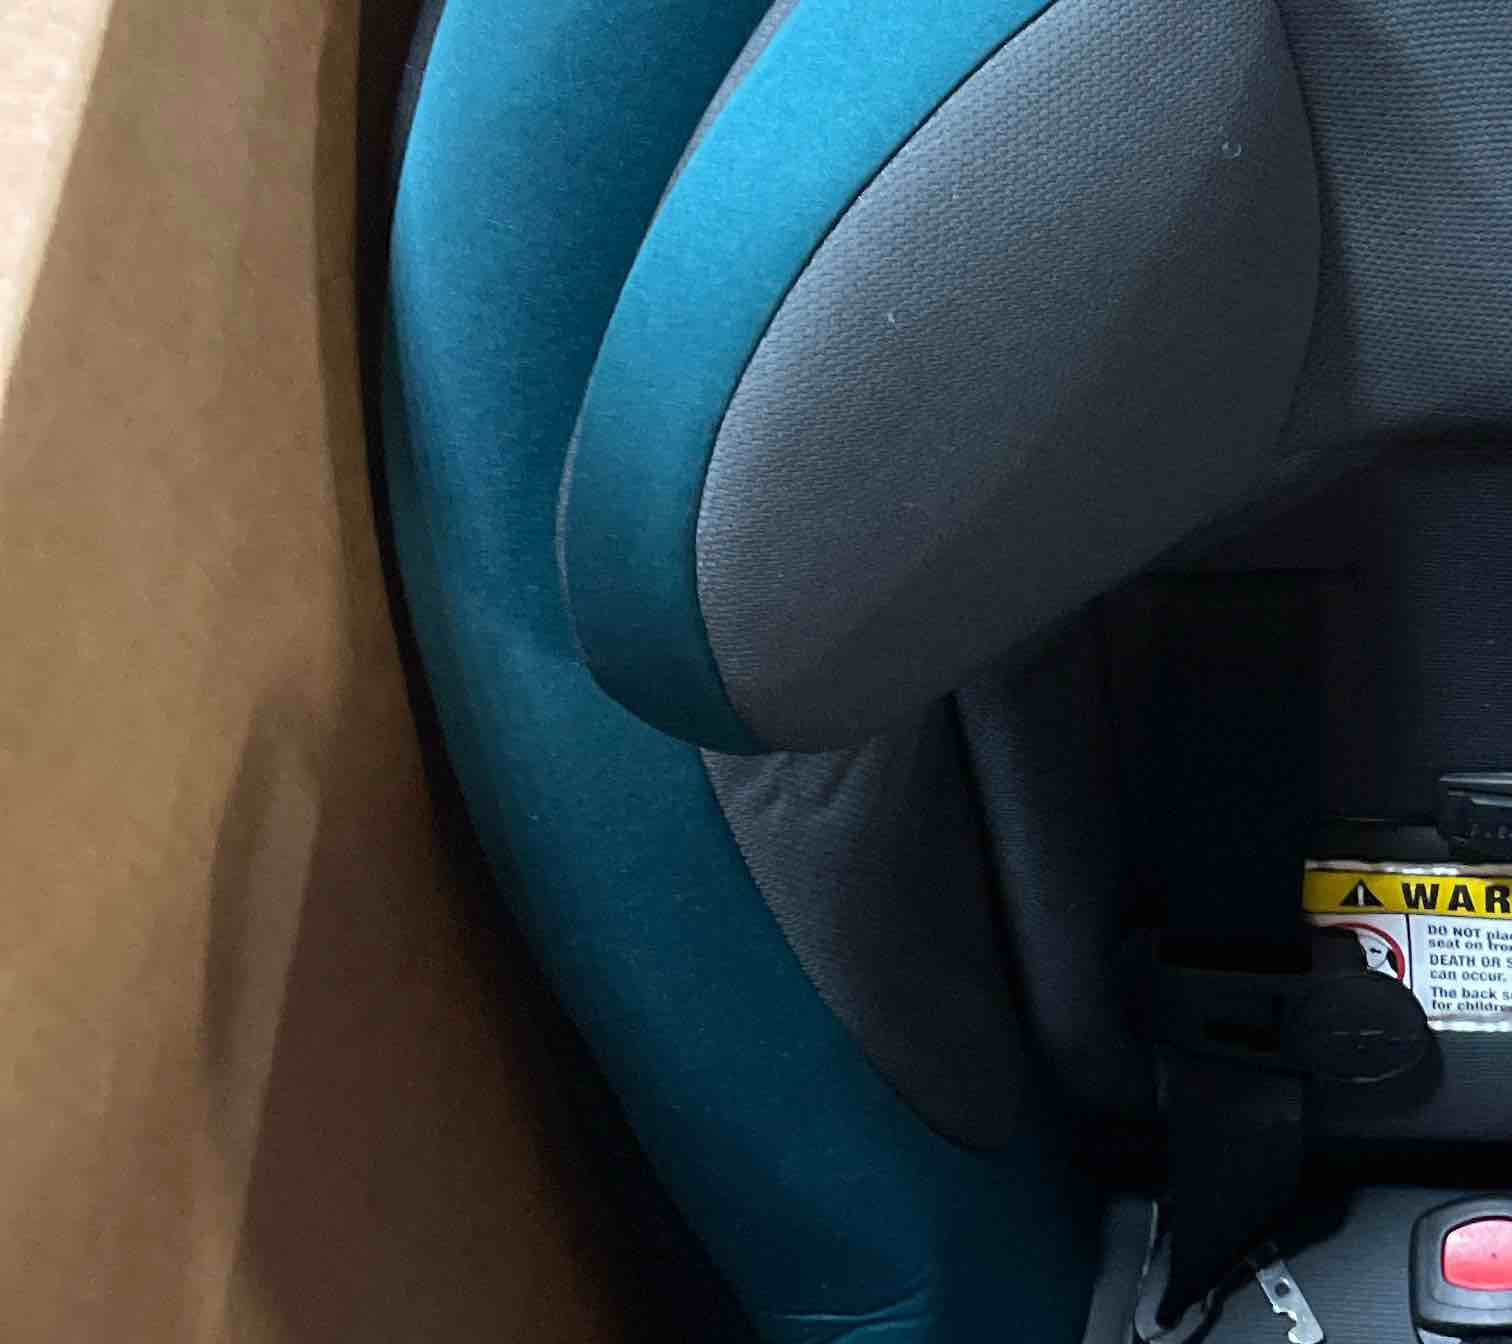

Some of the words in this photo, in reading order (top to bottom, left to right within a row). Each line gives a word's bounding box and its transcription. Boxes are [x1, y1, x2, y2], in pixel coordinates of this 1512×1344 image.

[1428, 925, 1447, 935] DO
[1453, 927, 1481, 938] NOT
[1428, 938, 1460, 949] seat
[1465, 941, 1483, 950] on
[1430, 954, 1475, 967] DEATH
[1481, 957, 1501, 968] OR
[1430, 971, 1456, 980] can
[1462, 972, 1507, 983] occur.
[1431, 987, 1457, 999] The
[1462, 987, 1497, 1000] back
